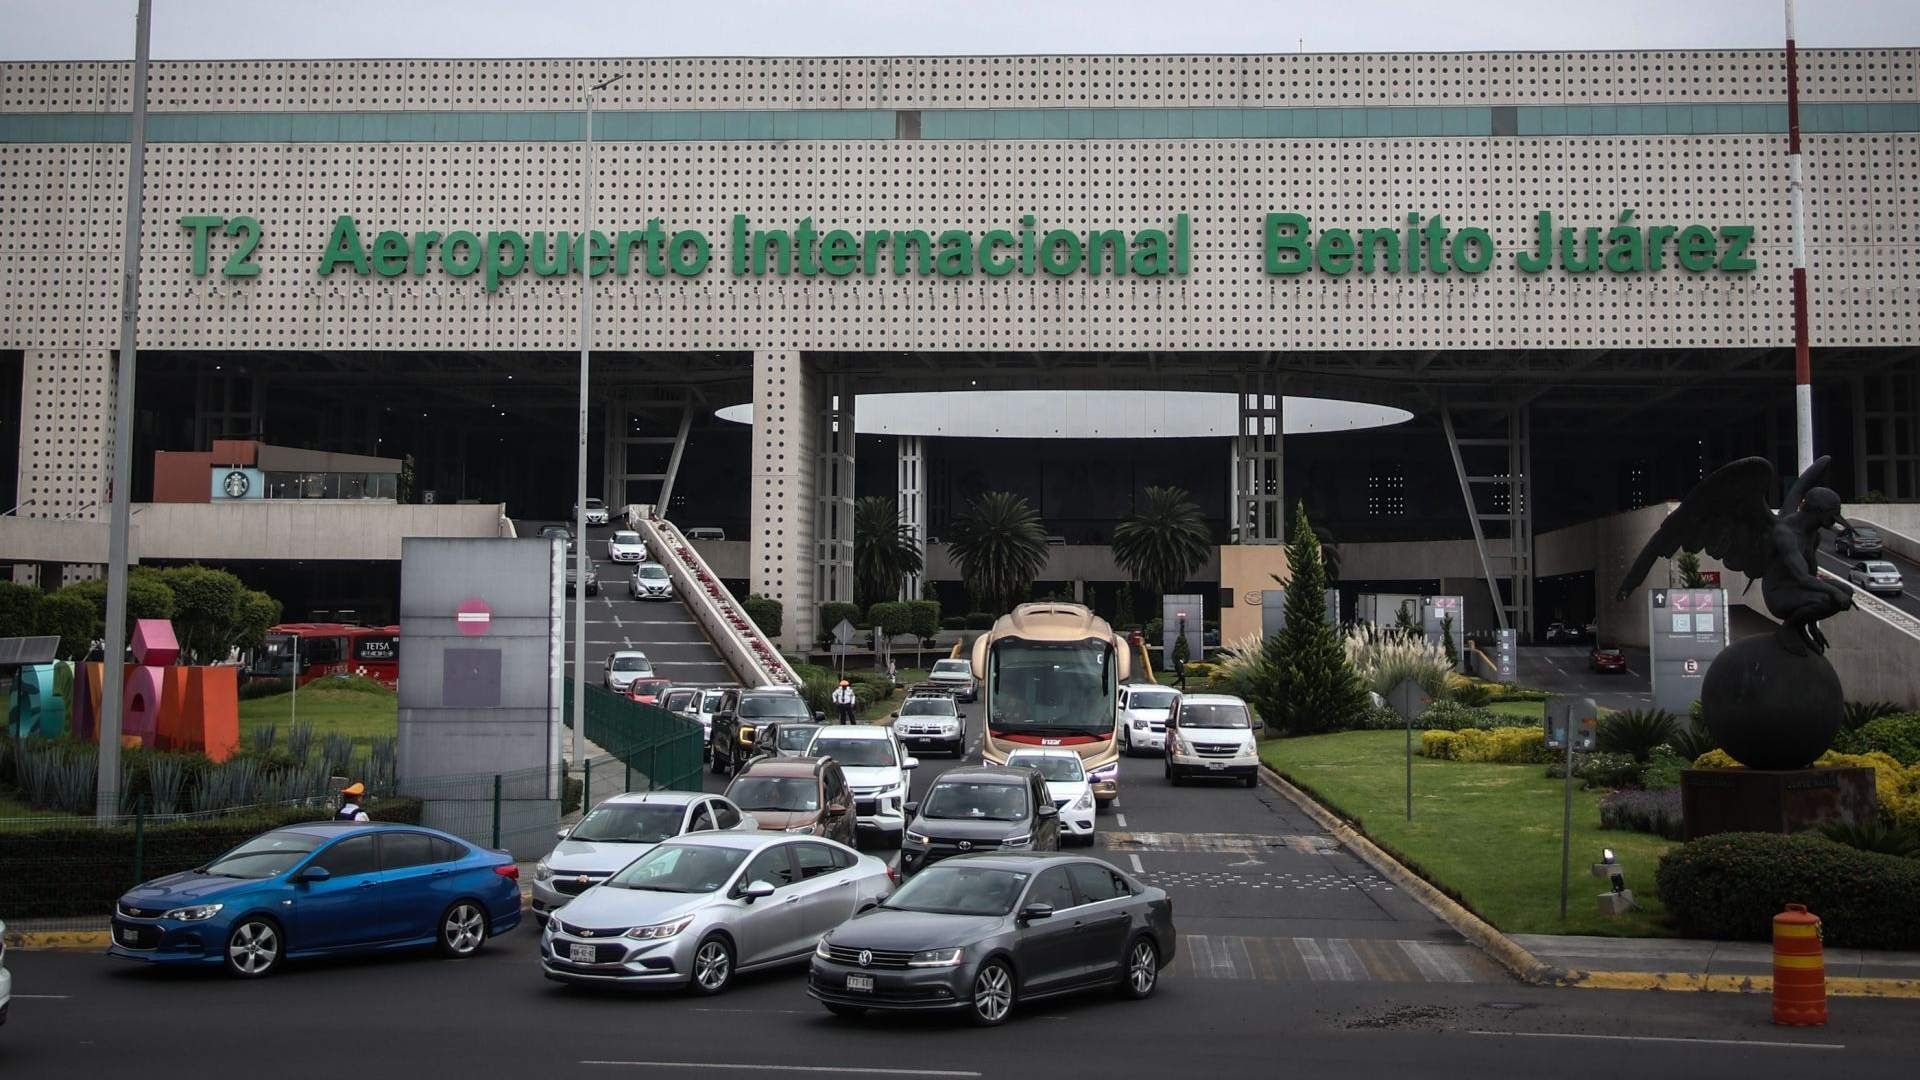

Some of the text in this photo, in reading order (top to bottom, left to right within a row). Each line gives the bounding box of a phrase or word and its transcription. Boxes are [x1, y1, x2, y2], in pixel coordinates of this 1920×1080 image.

[180, 208, 1757, 293] T2 Aeropuerto Internacional Benito Juárez
